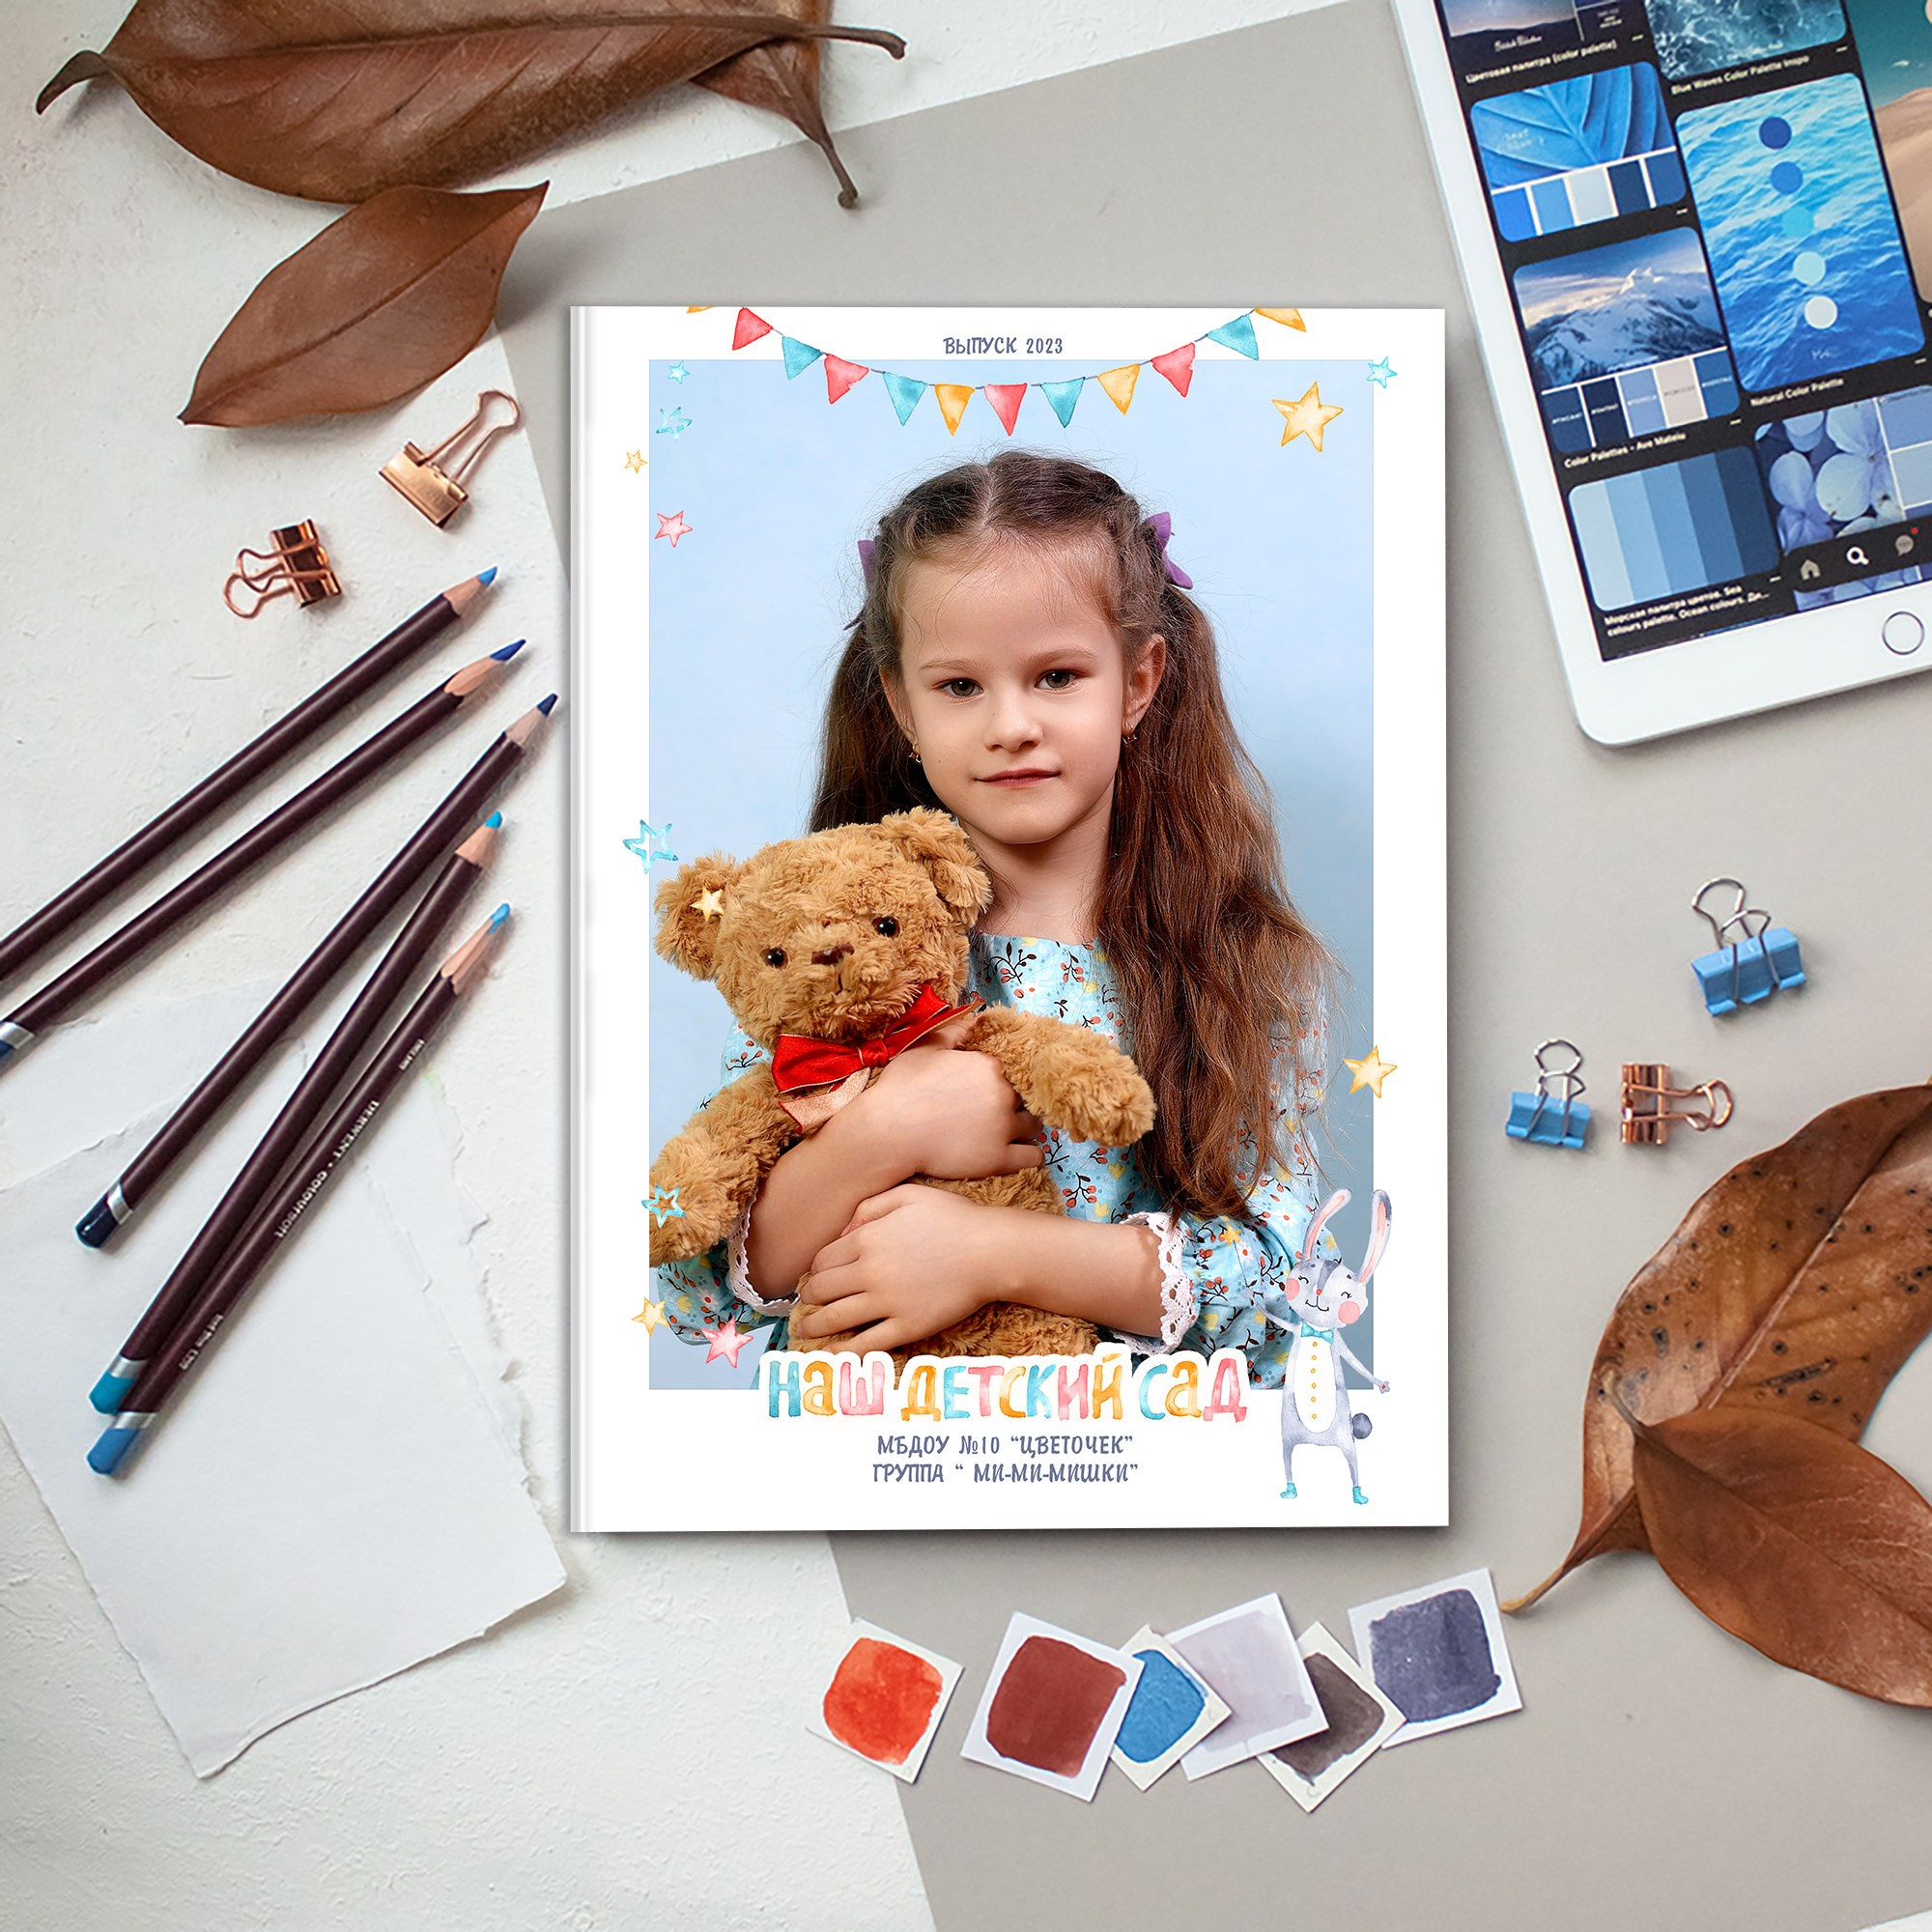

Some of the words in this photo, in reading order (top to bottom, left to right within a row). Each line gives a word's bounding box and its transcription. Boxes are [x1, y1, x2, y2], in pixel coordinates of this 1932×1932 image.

[1670, 81, 1692, 95] Blue
[1691, 74, 1722, 90] Waves
[1722, 68, 1749, 82] Color
[1748, 59, 1782, 75] Palette
[943, 337, 1017, 355] ВЫПУСК
[1026, 338, 1063, 354] 2023
[1749, 390, 1784, 408] Natural
[1783, 384, 1810, 399] Color
[1810, 375, 1844, 392] Palette
[1563, 453, 1589, 469] Color
[1722, 583, 1742, 596] Sea
[331, 1098, 381, 1159] DERWENT
[900, 1353, 1123, 1422] ДЕТСКИЙ
[877, 1435, 950, 1458] МБДОУ
[959, 1435, 1000, 1455] №10
[873, 1463, 944, 1483] ГРУППА
